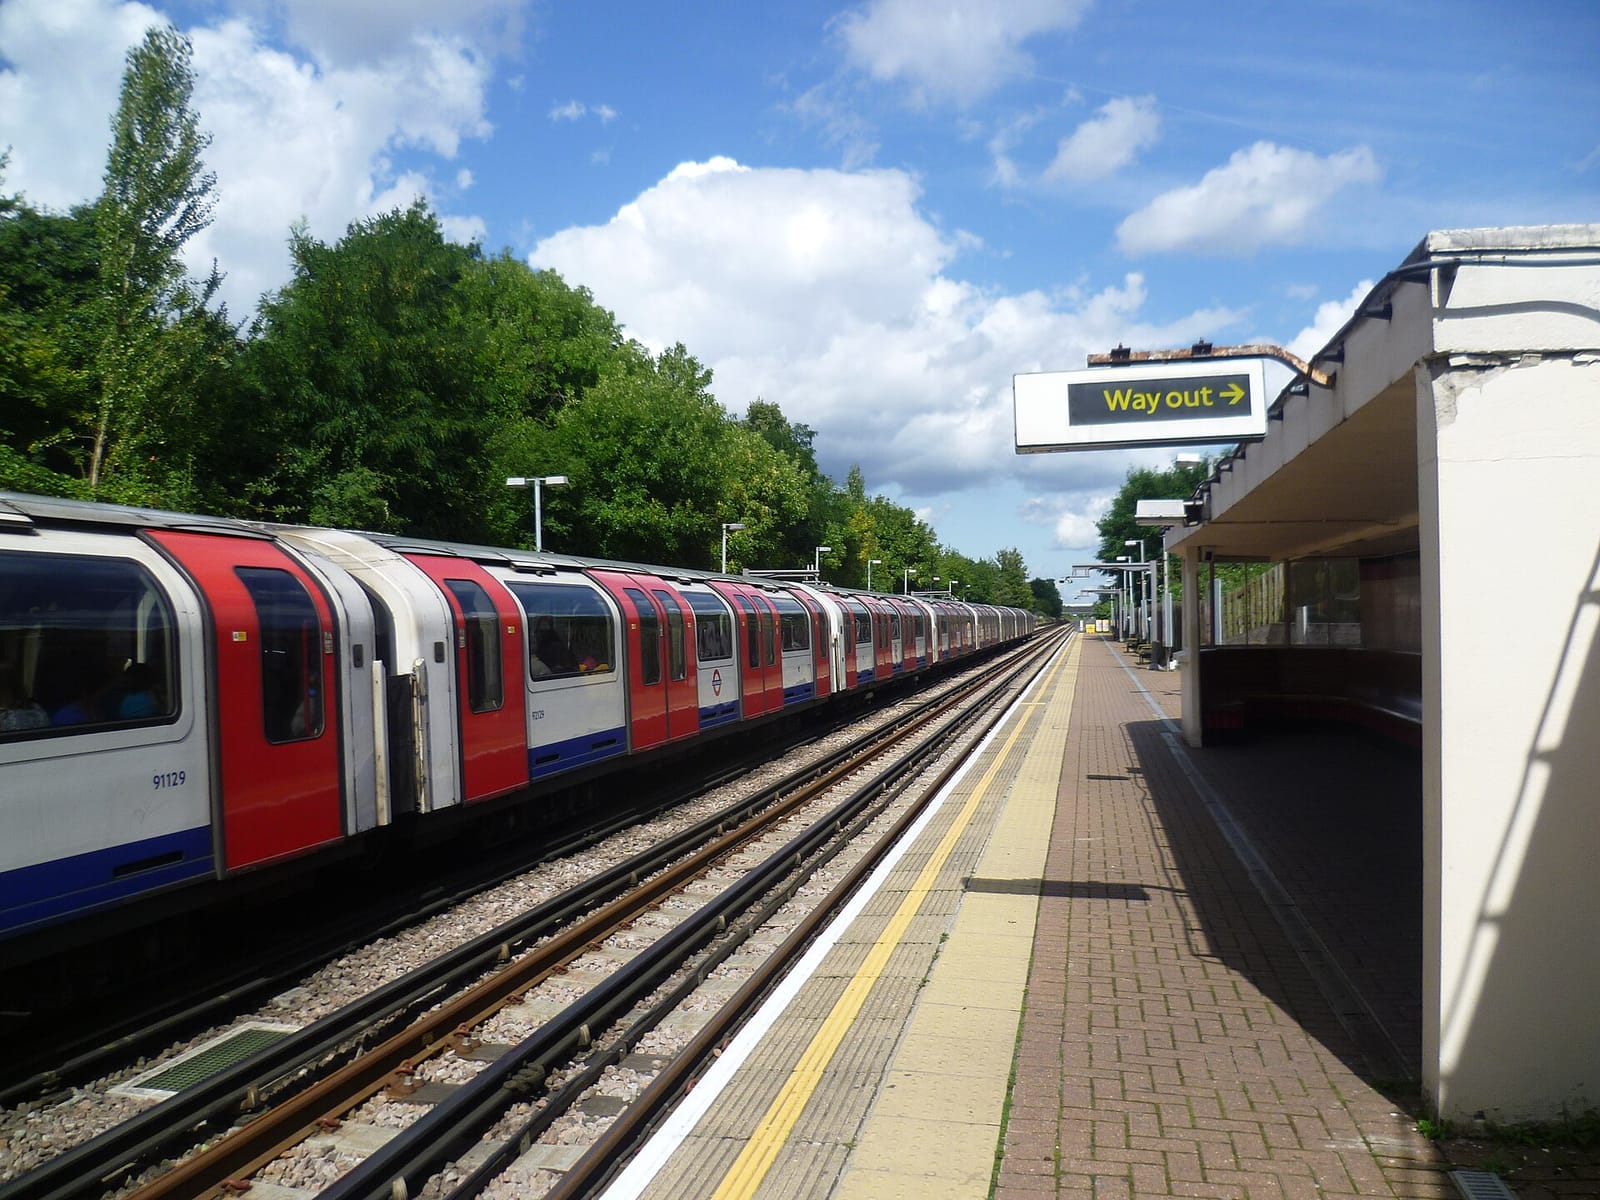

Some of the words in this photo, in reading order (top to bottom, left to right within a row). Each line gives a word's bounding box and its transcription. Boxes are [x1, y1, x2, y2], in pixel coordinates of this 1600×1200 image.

[1103, 388, 1161, 415] Way
[1165, 386, 1214, 409] out
[153, 770, 186, 790] 91129
